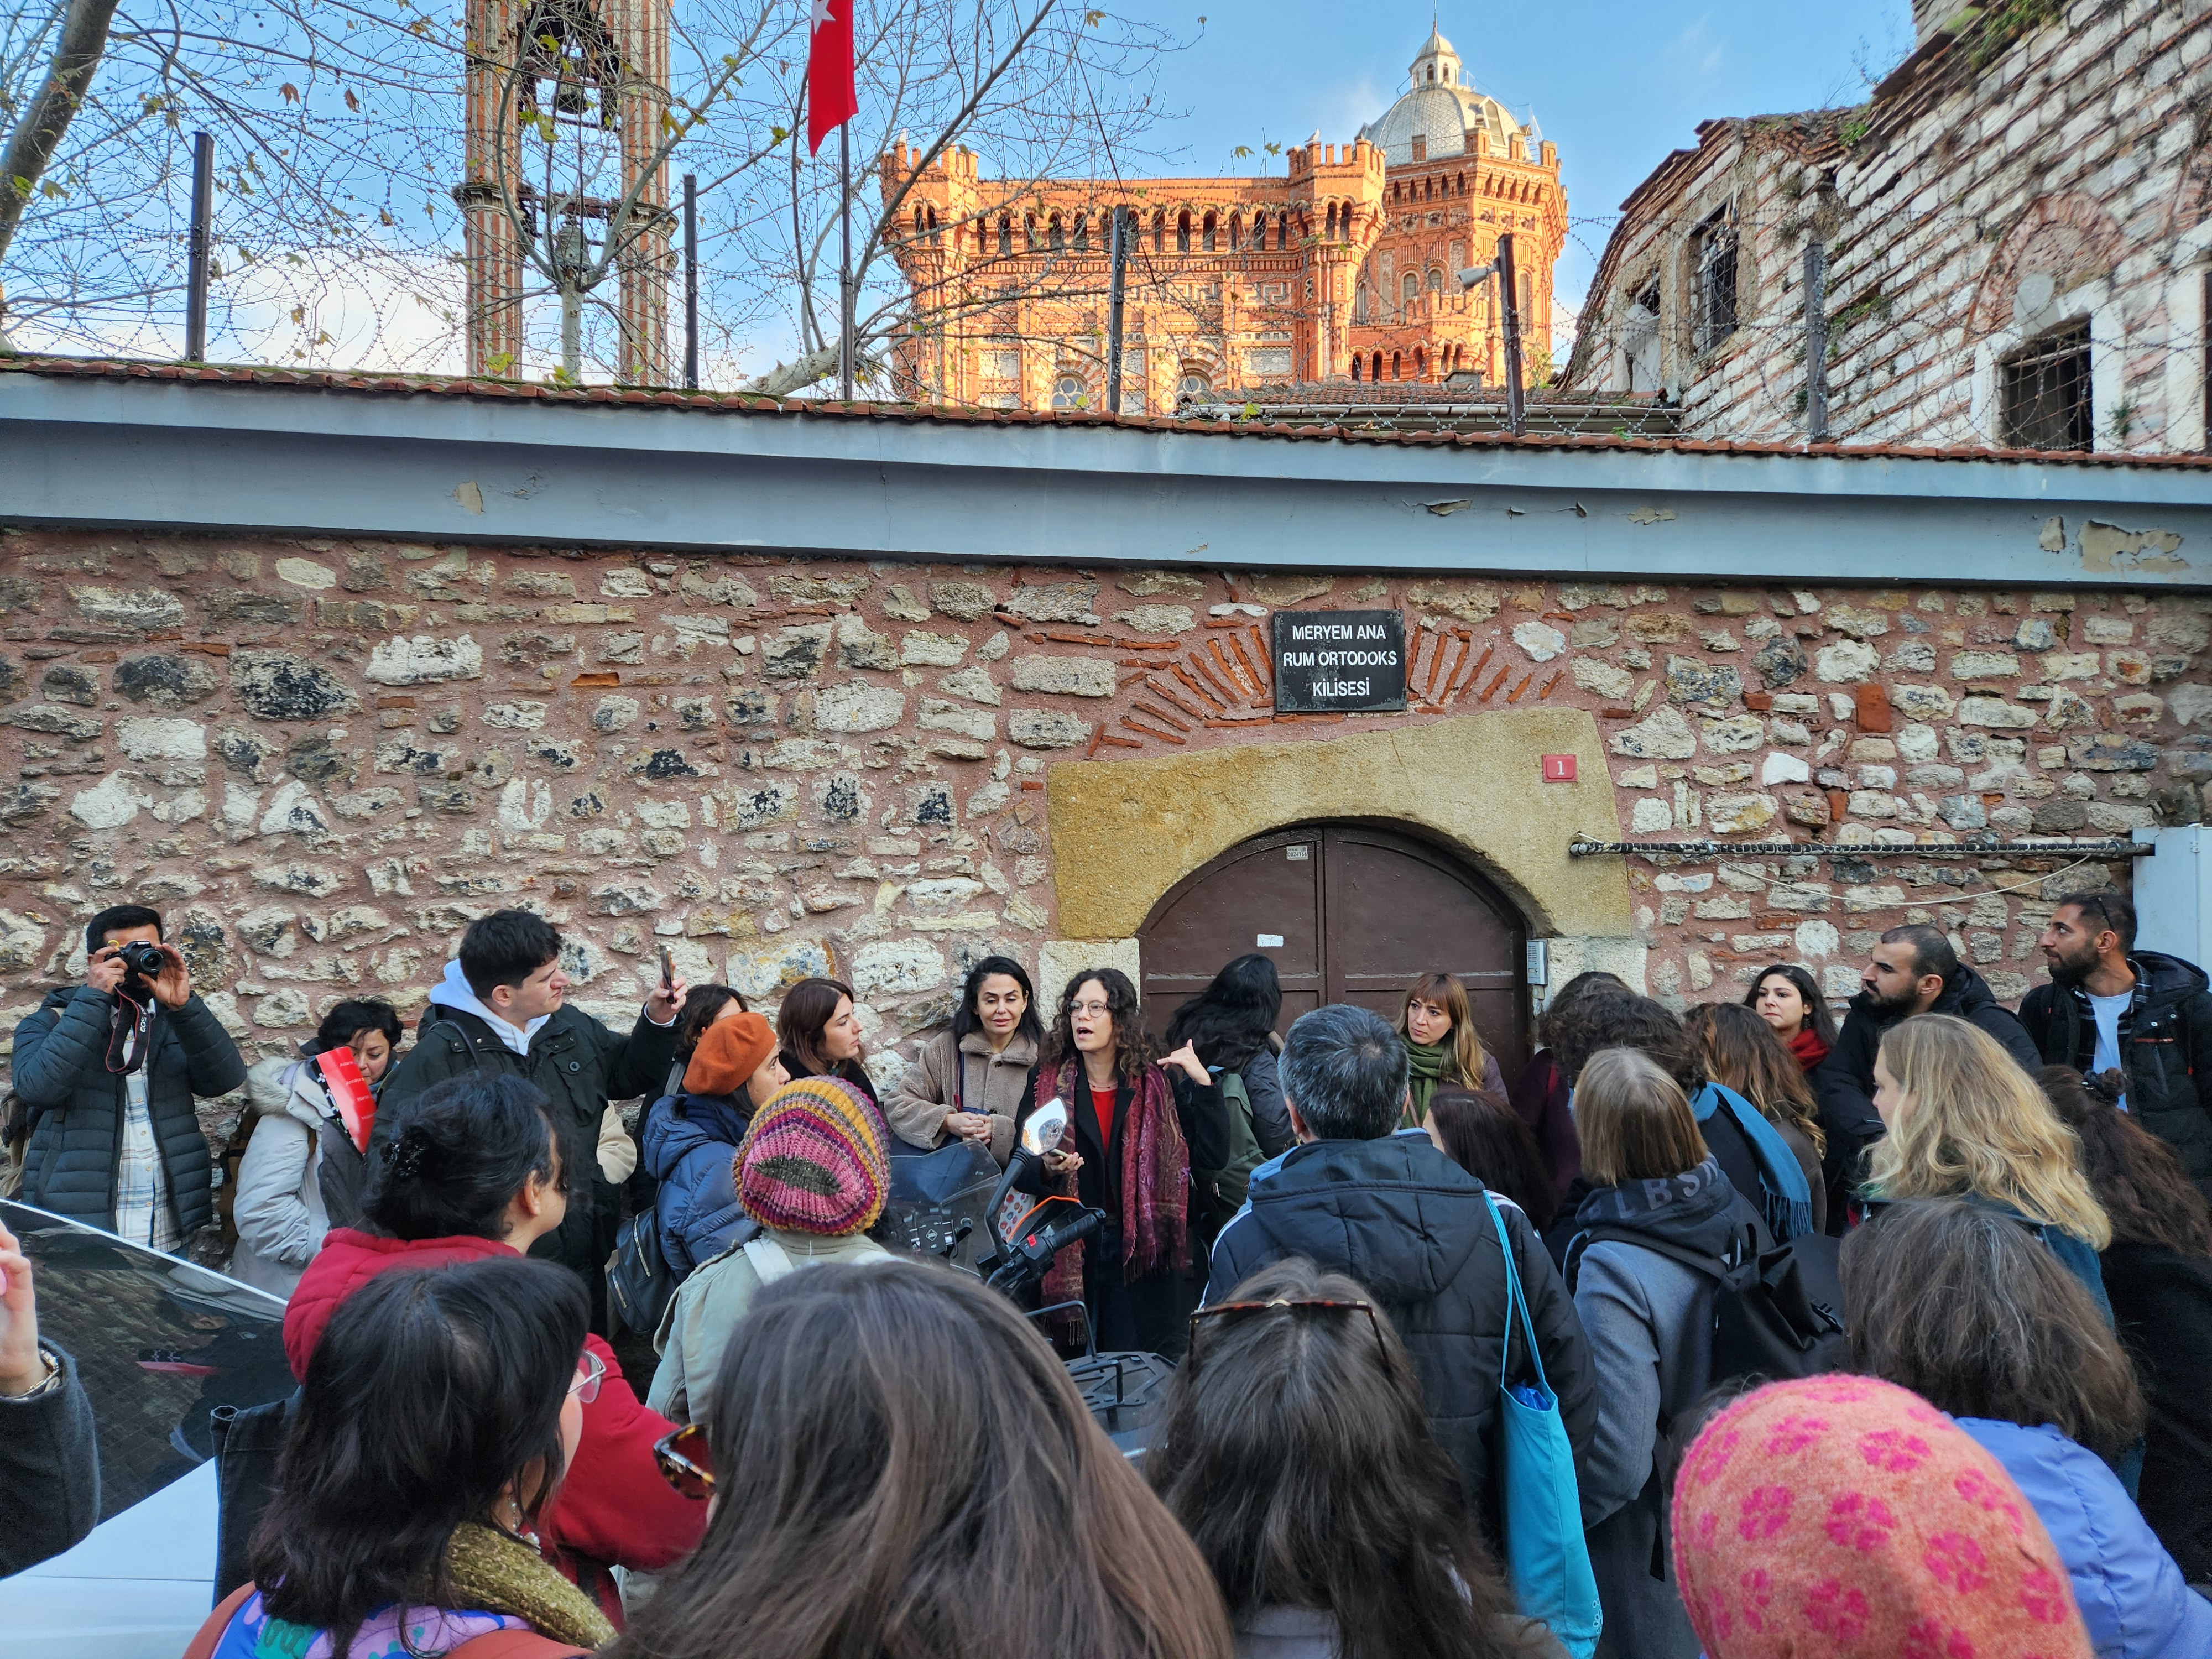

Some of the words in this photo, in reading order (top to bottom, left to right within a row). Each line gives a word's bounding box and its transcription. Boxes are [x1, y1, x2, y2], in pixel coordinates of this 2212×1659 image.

[1292, 625, 1352, 640] MERYEM
[1357, 625, 1386, 639] ANA
[1283, 651, 1314, 666] RUM
[1318, 650, 1397, 666] ORTODOKS
[1313, 677, 1370, 696] KİLİSESİ
[1557, 760, 1565, 776] 1
